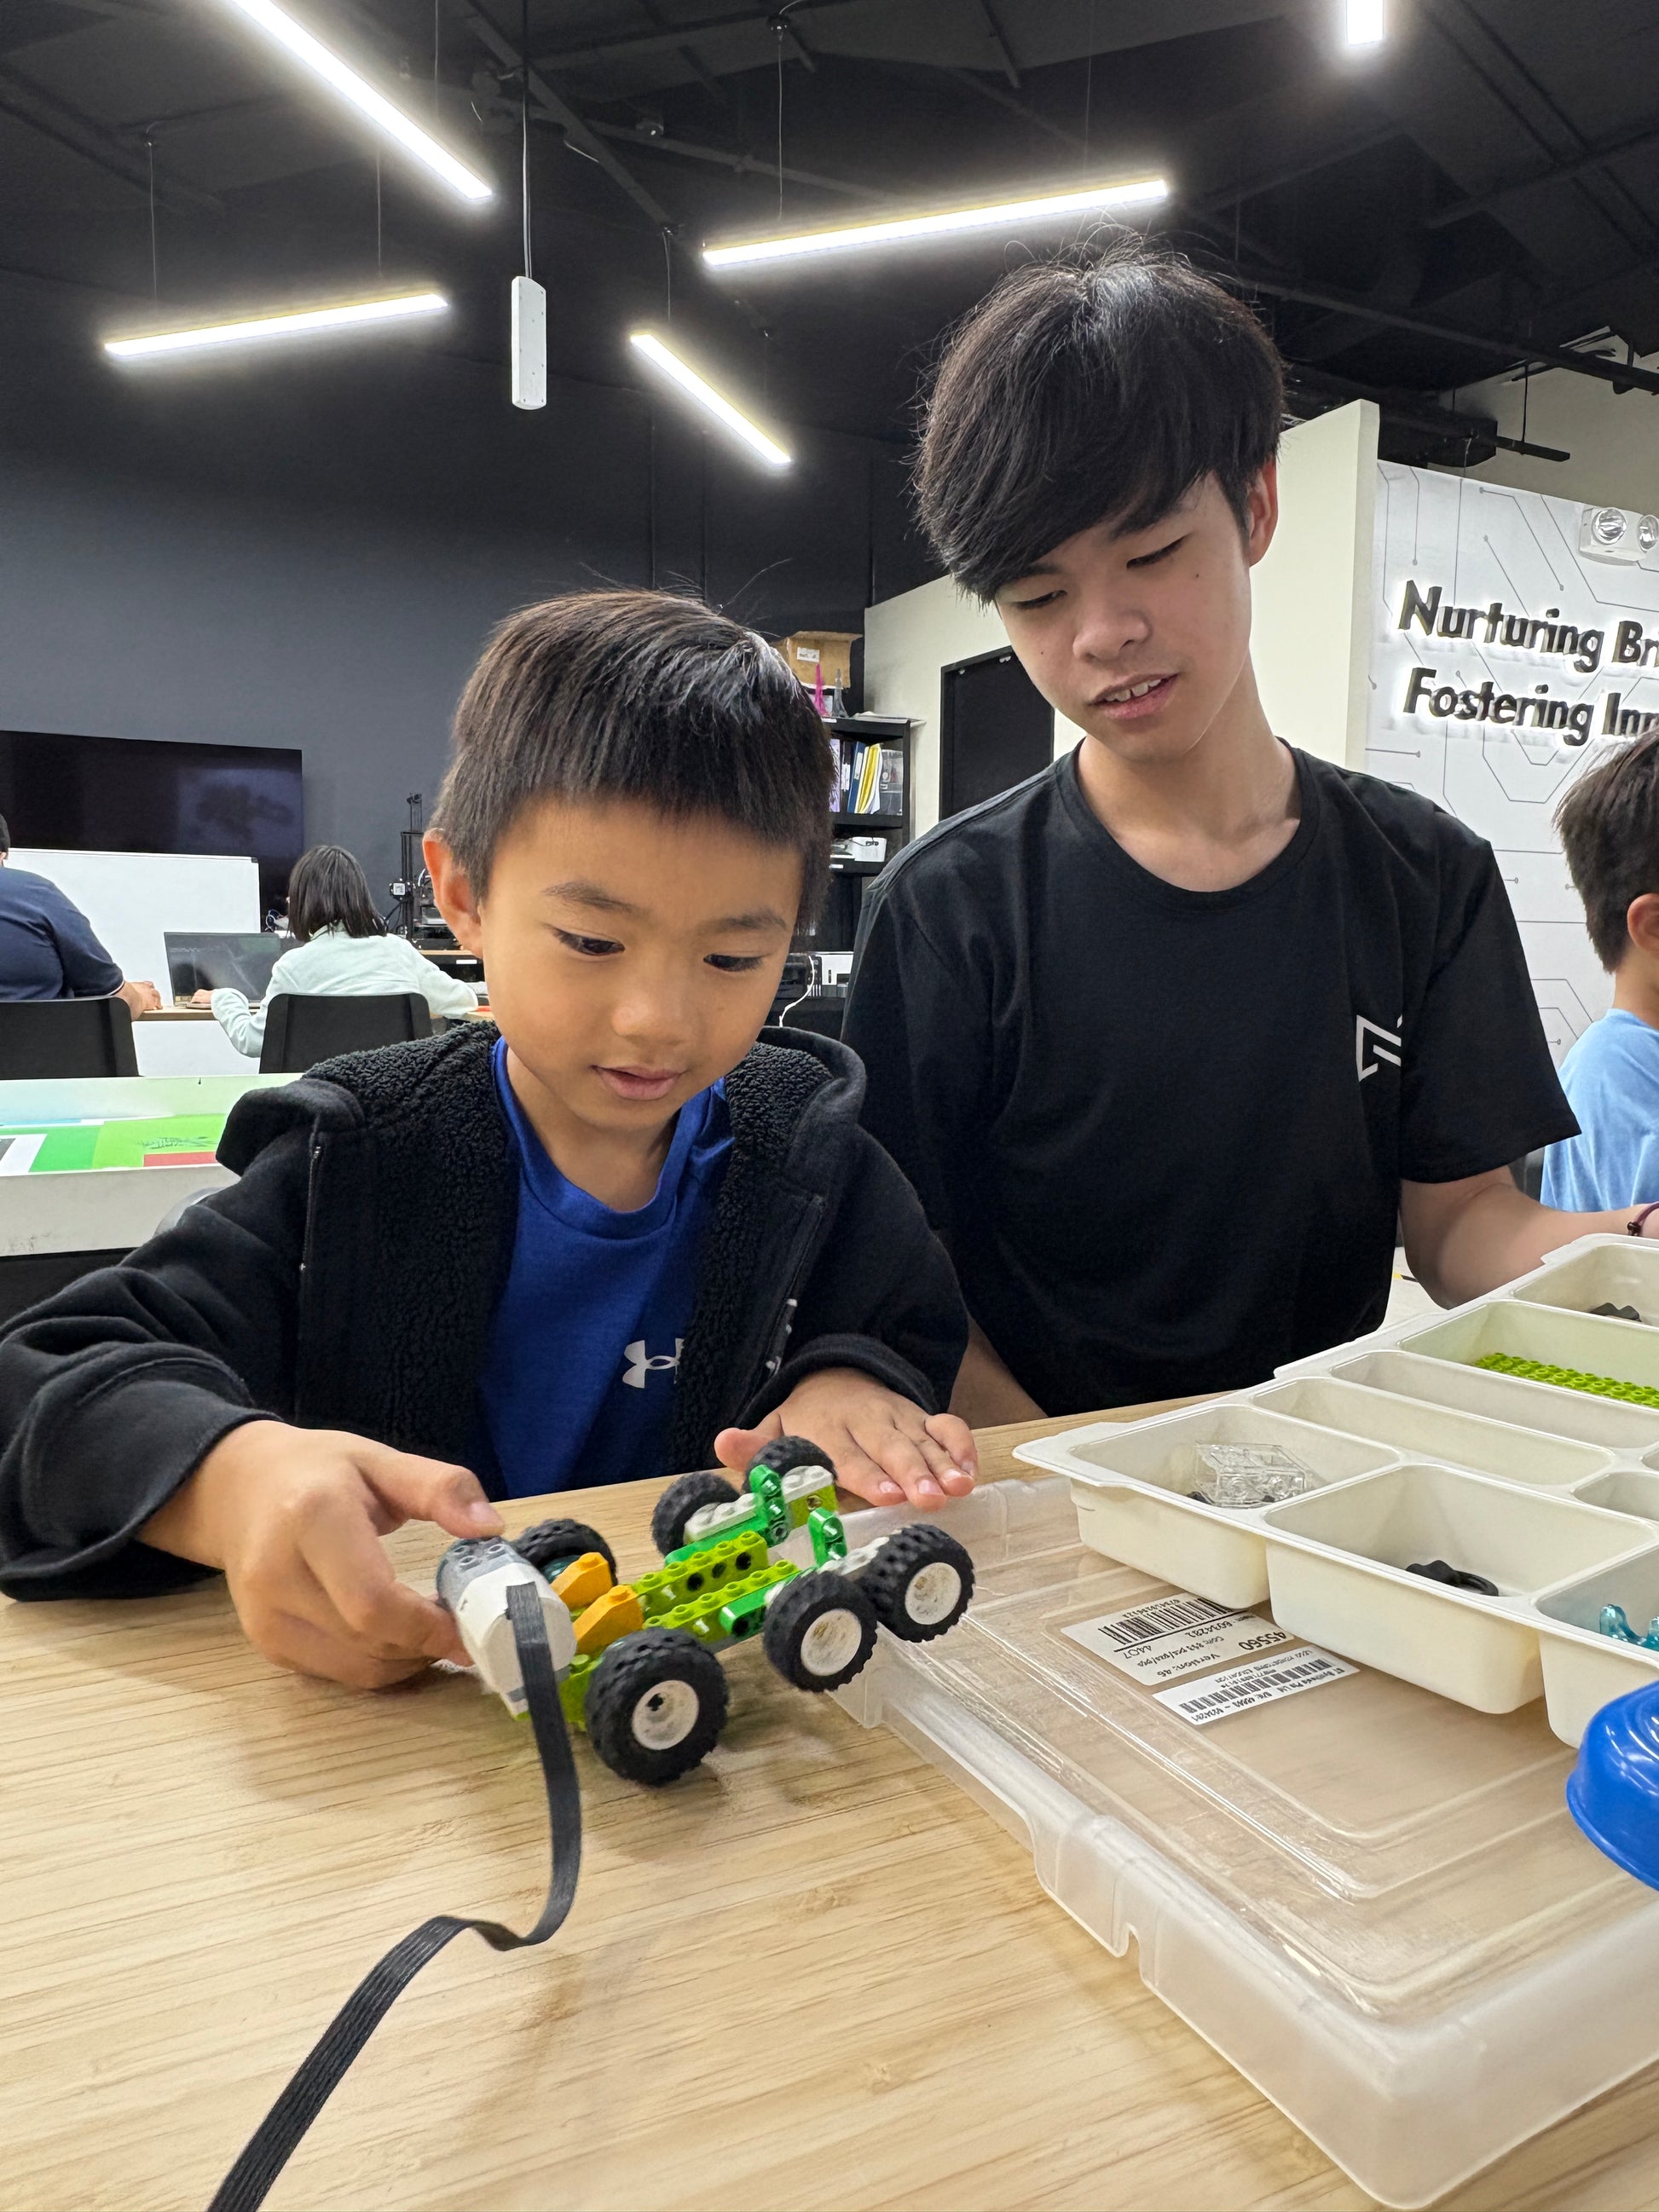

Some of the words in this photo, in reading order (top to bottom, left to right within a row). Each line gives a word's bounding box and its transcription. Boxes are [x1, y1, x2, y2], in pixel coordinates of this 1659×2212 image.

[1397, 580, 1604, 673] Nurturing
[1612, 621, 1659, 667] Br
[1403, 667, 1594, 747] Fostering
[1239, 1632, 1287, 1650] 45560
